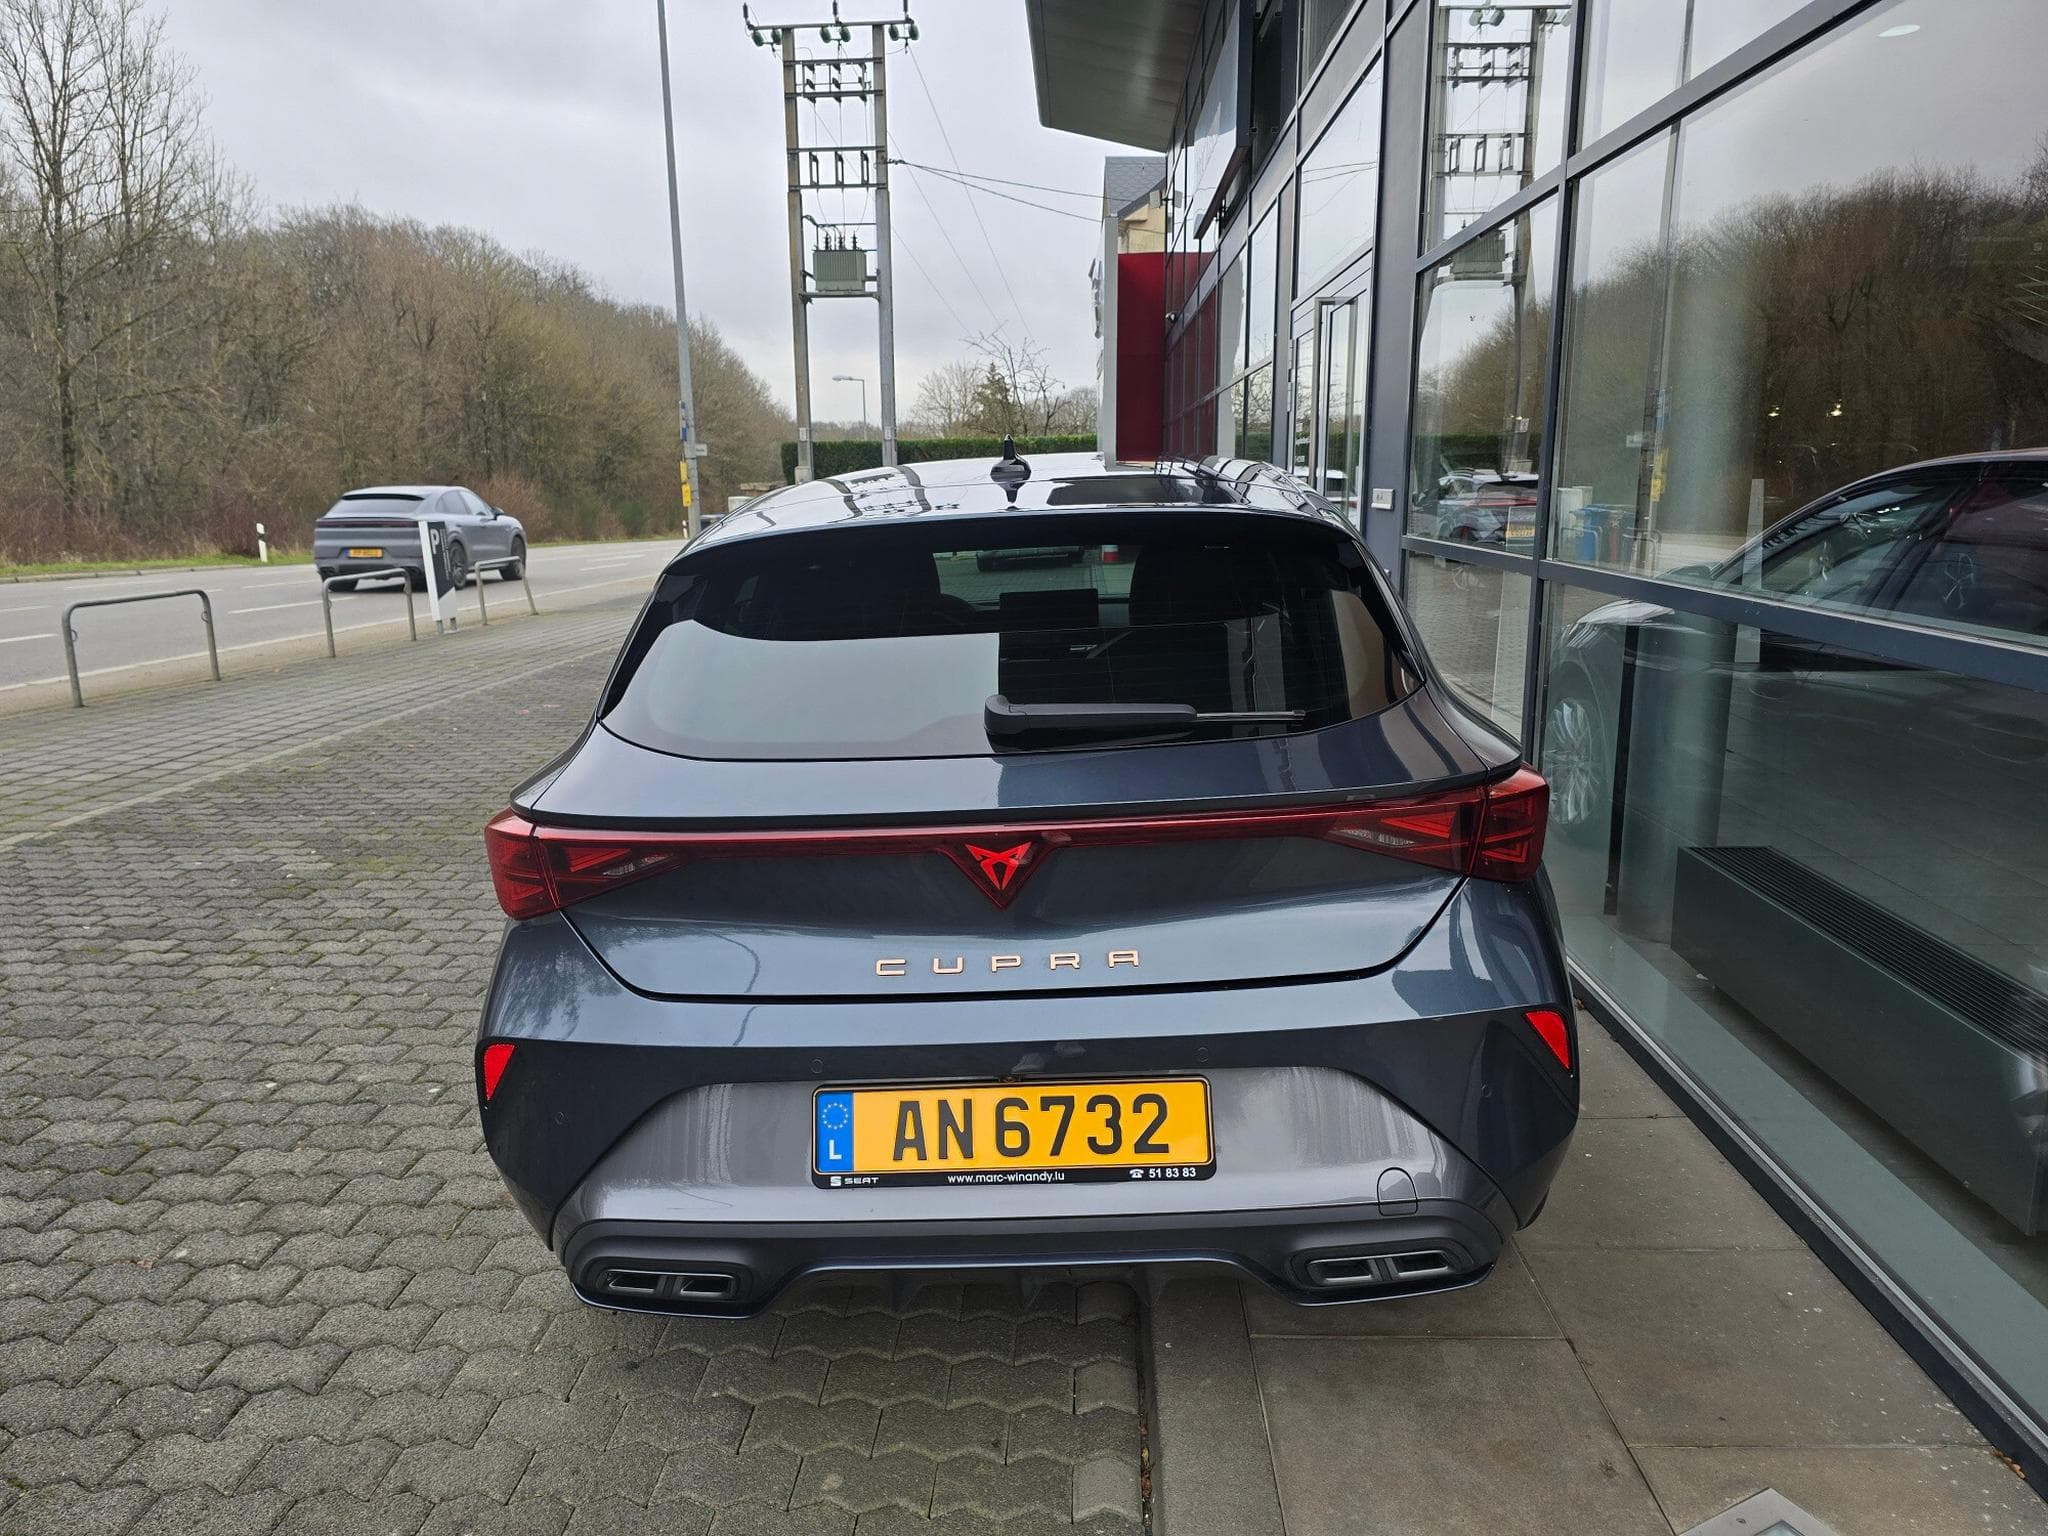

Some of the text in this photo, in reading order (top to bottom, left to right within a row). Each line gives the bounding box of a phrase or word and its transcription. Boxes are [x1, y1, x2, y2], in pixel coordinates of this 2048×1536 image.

[875, 949, 1140, 976] CUPRA
[892, 1093, 1170, 1161] AN 6732
[828, 1139, 842, 1160] L
[844, 1176, 880, 1185] SEAT
[947, 1171, 1065, 1184] www.marc-winandy.lu
[1149, 1167, 1197, 1179] 51 83 83
